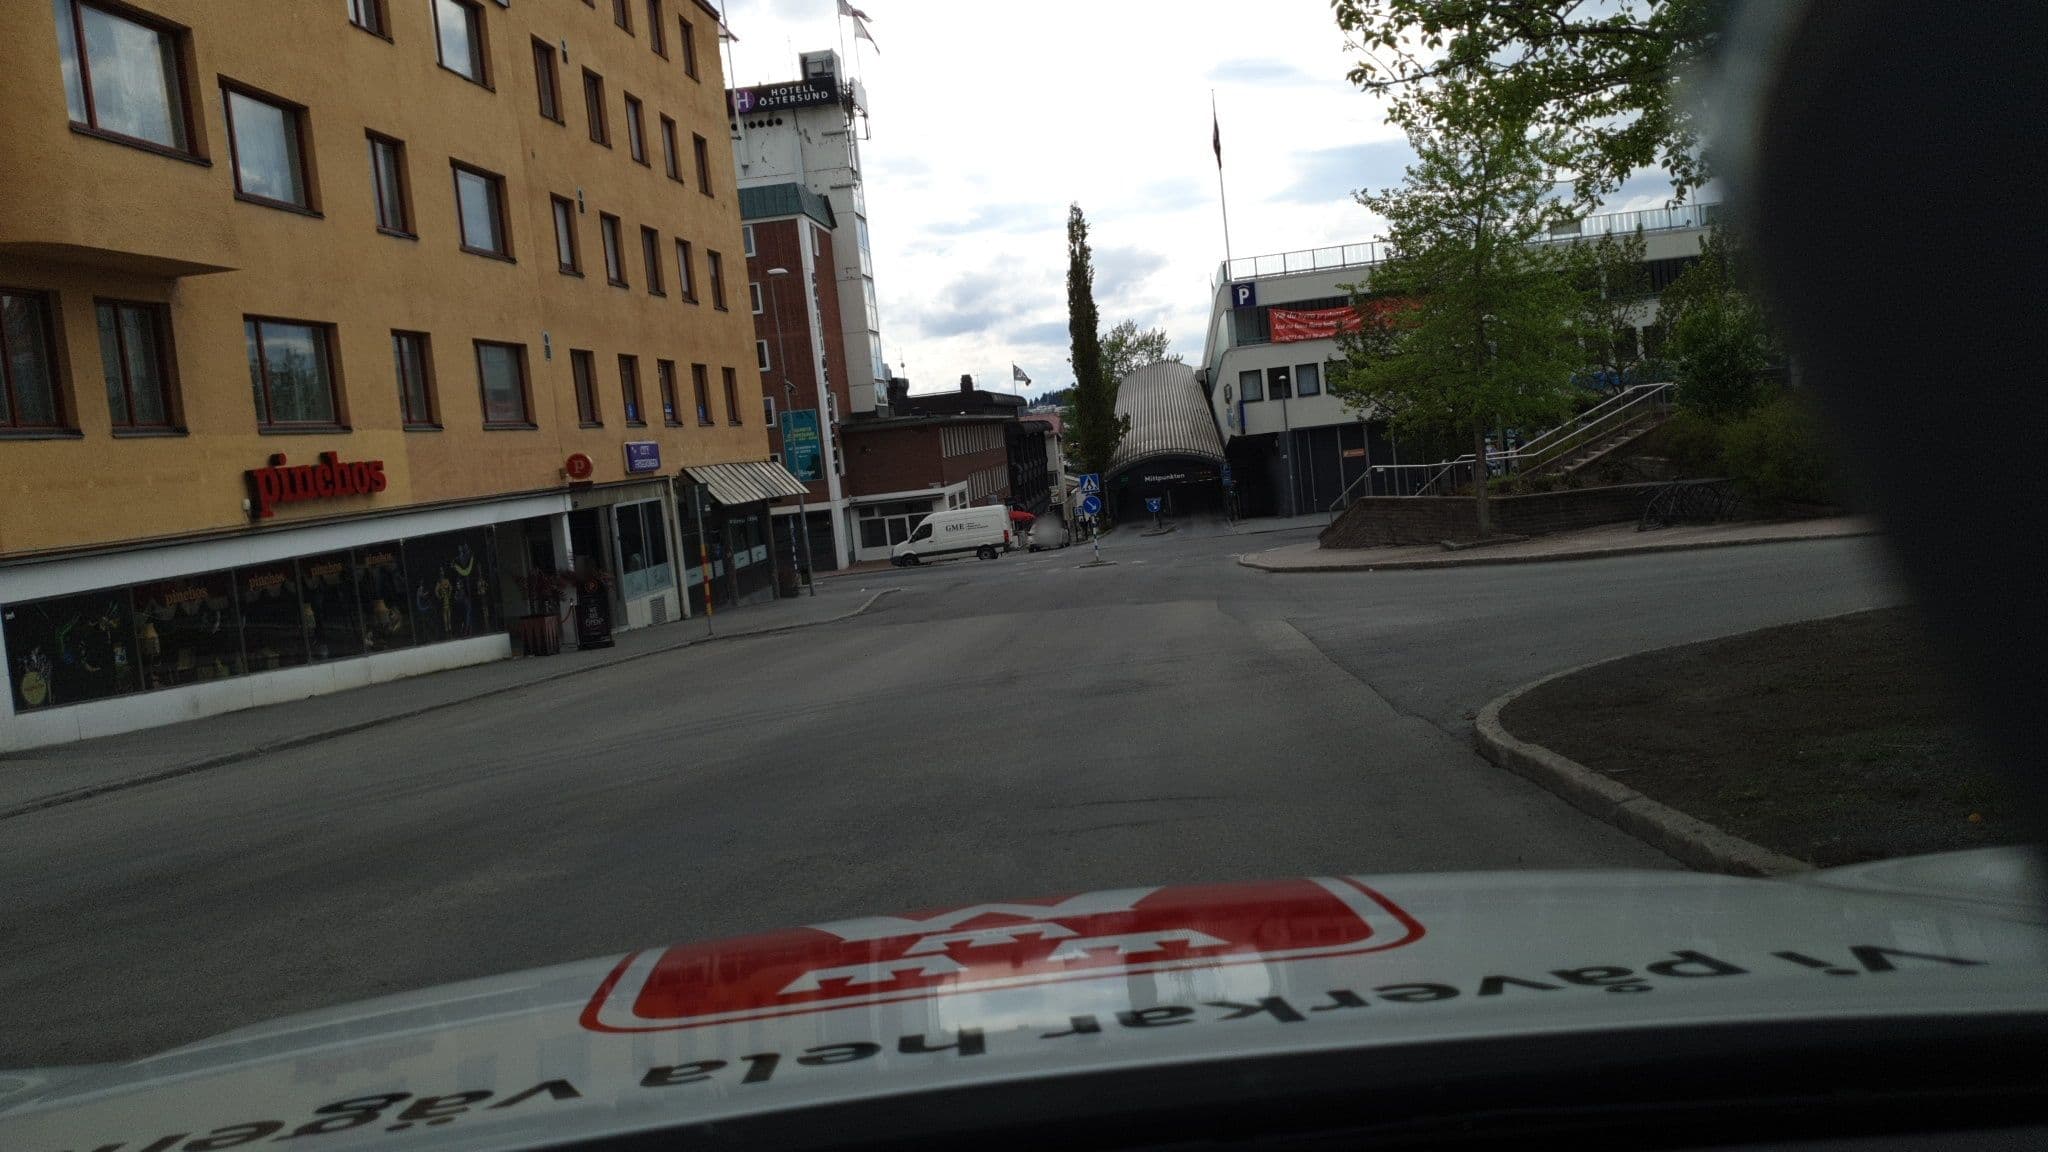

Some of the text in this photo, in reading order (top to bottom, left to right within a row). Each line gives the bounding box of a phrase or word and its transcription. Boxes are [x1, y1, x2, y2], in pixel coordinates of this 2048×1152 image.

[771, 84, 815, 96] HOTELL
[759, 91, 829, 107] ÖSTERSUND
[1239, 288, 1250, 305] P
[574, 460, 585, 473] P
[245, 451, 387, 520] pinchos
[1144, 473, 1185, 483] Mittpunkten
[945, 524, 965, 532] GME
[164, 585, 210, 607] pinchos
[1772, 944, 1991, 975] Vi
[1043, 948, 1748, 1040] påverkar
[640, 1025, 986, 1086] hela
